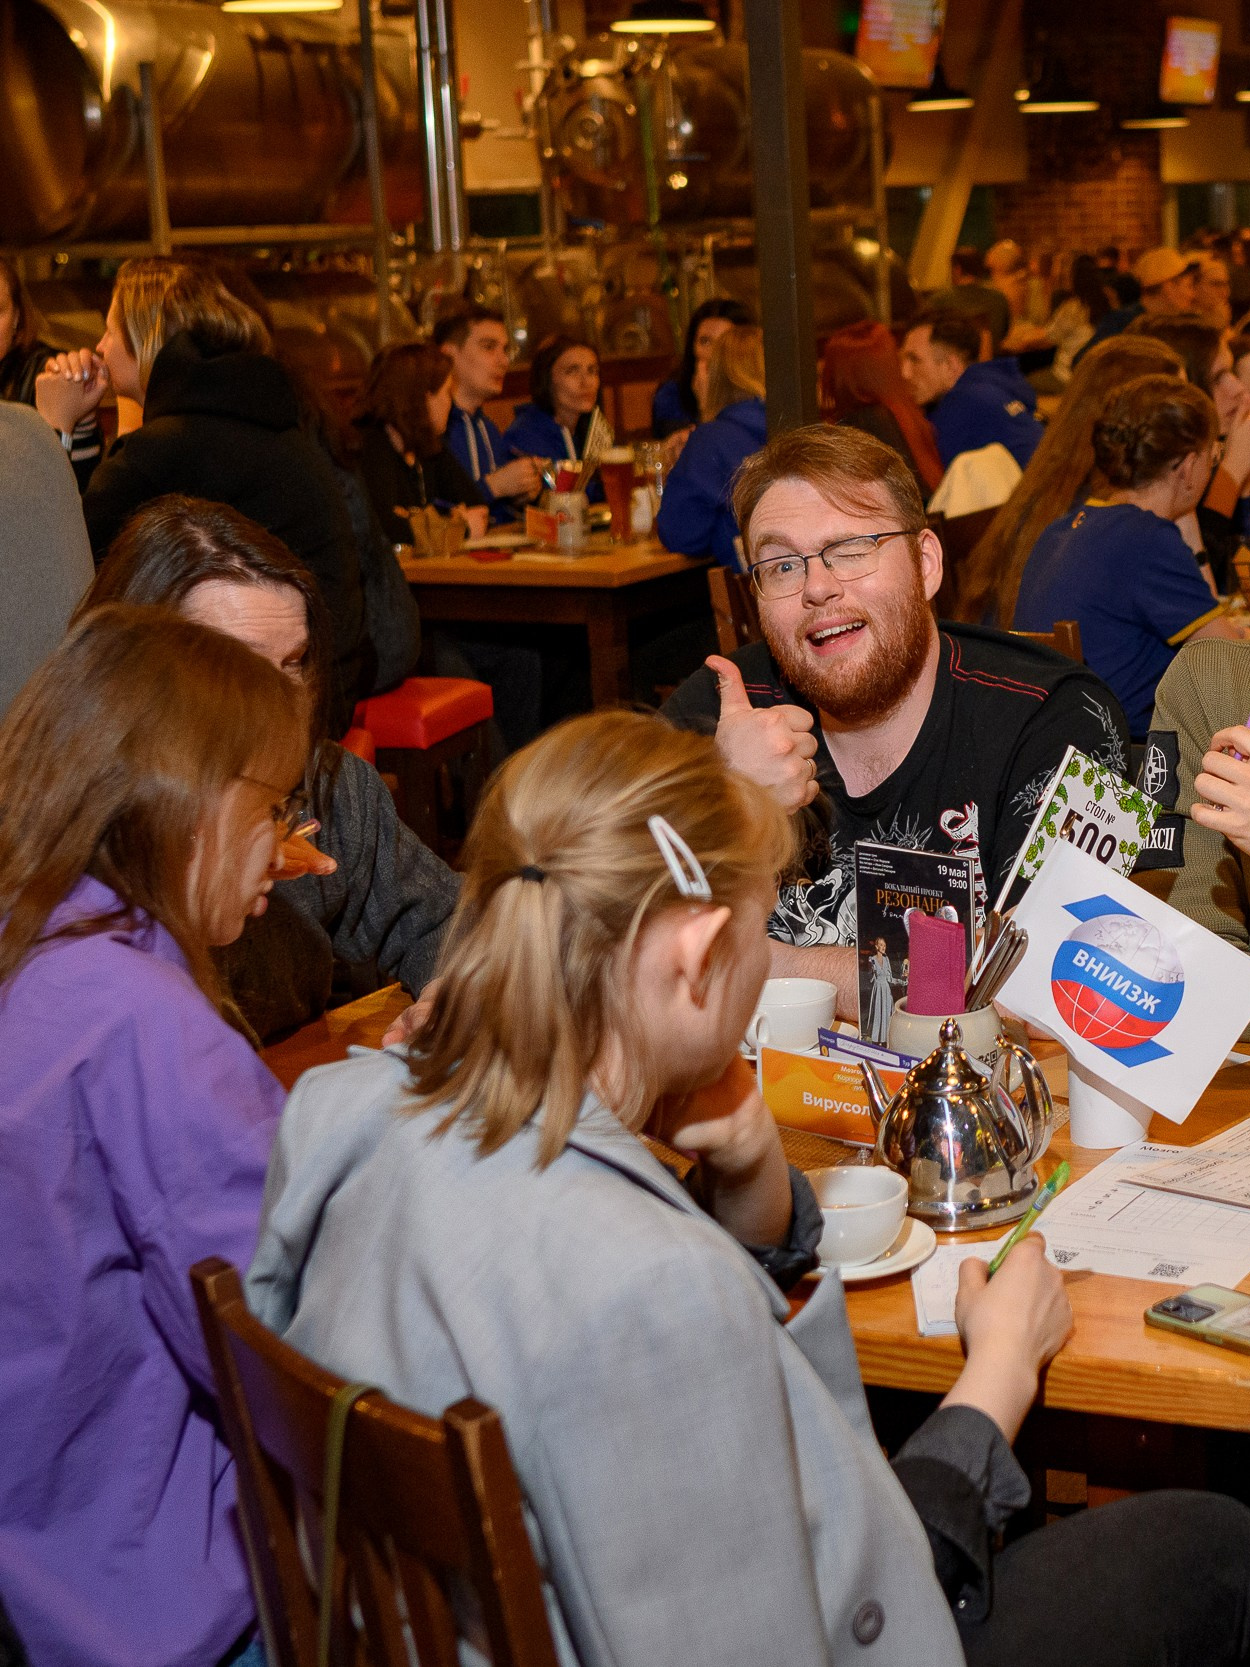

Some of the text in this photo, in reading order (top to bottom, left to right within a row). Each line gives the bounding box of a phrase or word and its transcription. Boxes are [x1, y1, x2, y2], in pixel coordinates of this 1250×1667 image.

[1085, 800, 1106, 820] СТОЛ
[937, 865, 967, 878] 19 мая
[884, 882, 944, 898] ВОКАЛЬНЫЙ ПРОЕКТ
[948, 878, 968, 890] 19:00
[1072, 949, 1161, 1014] ВНИИЗЖ
